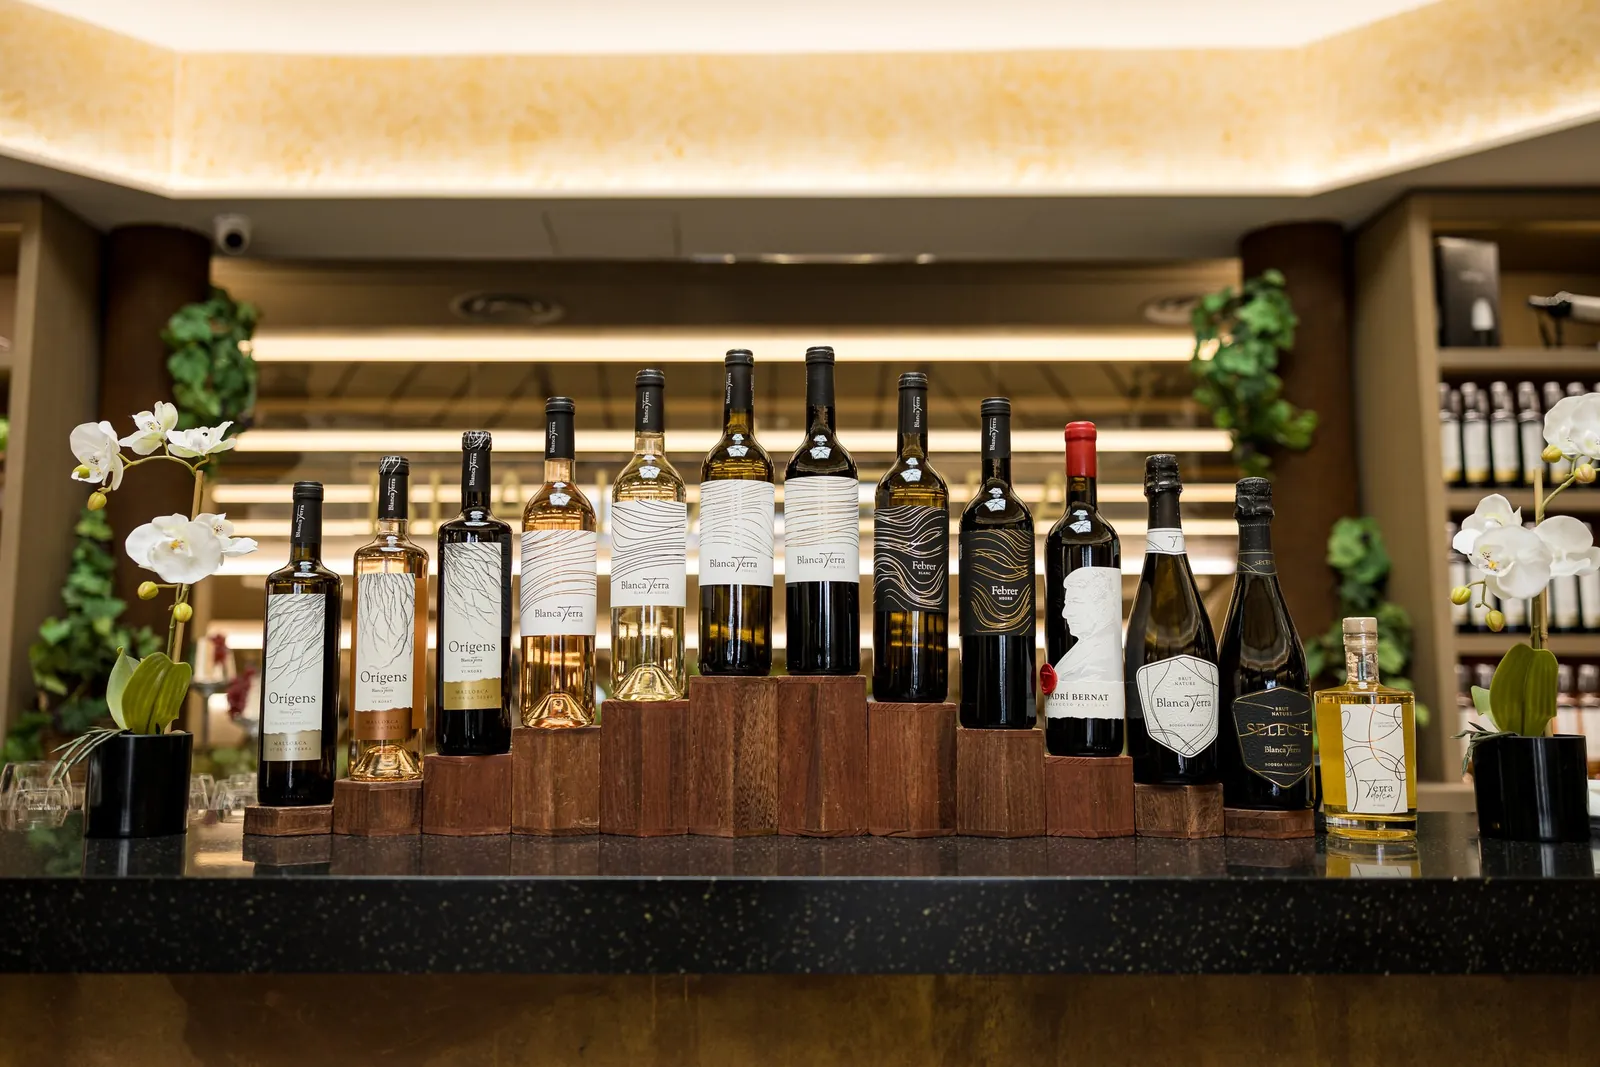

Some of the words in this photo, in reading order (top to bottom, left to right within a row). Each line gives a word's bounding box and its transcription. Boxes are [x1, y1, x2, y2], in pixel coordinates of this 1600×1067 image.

[912, 560, 937, 571] Febrer
[991, 585, 1019, 596] Febrer
[1072, 693, 1109, 701] BERNAT
[1246, 722, 1310, 737] SELECT
